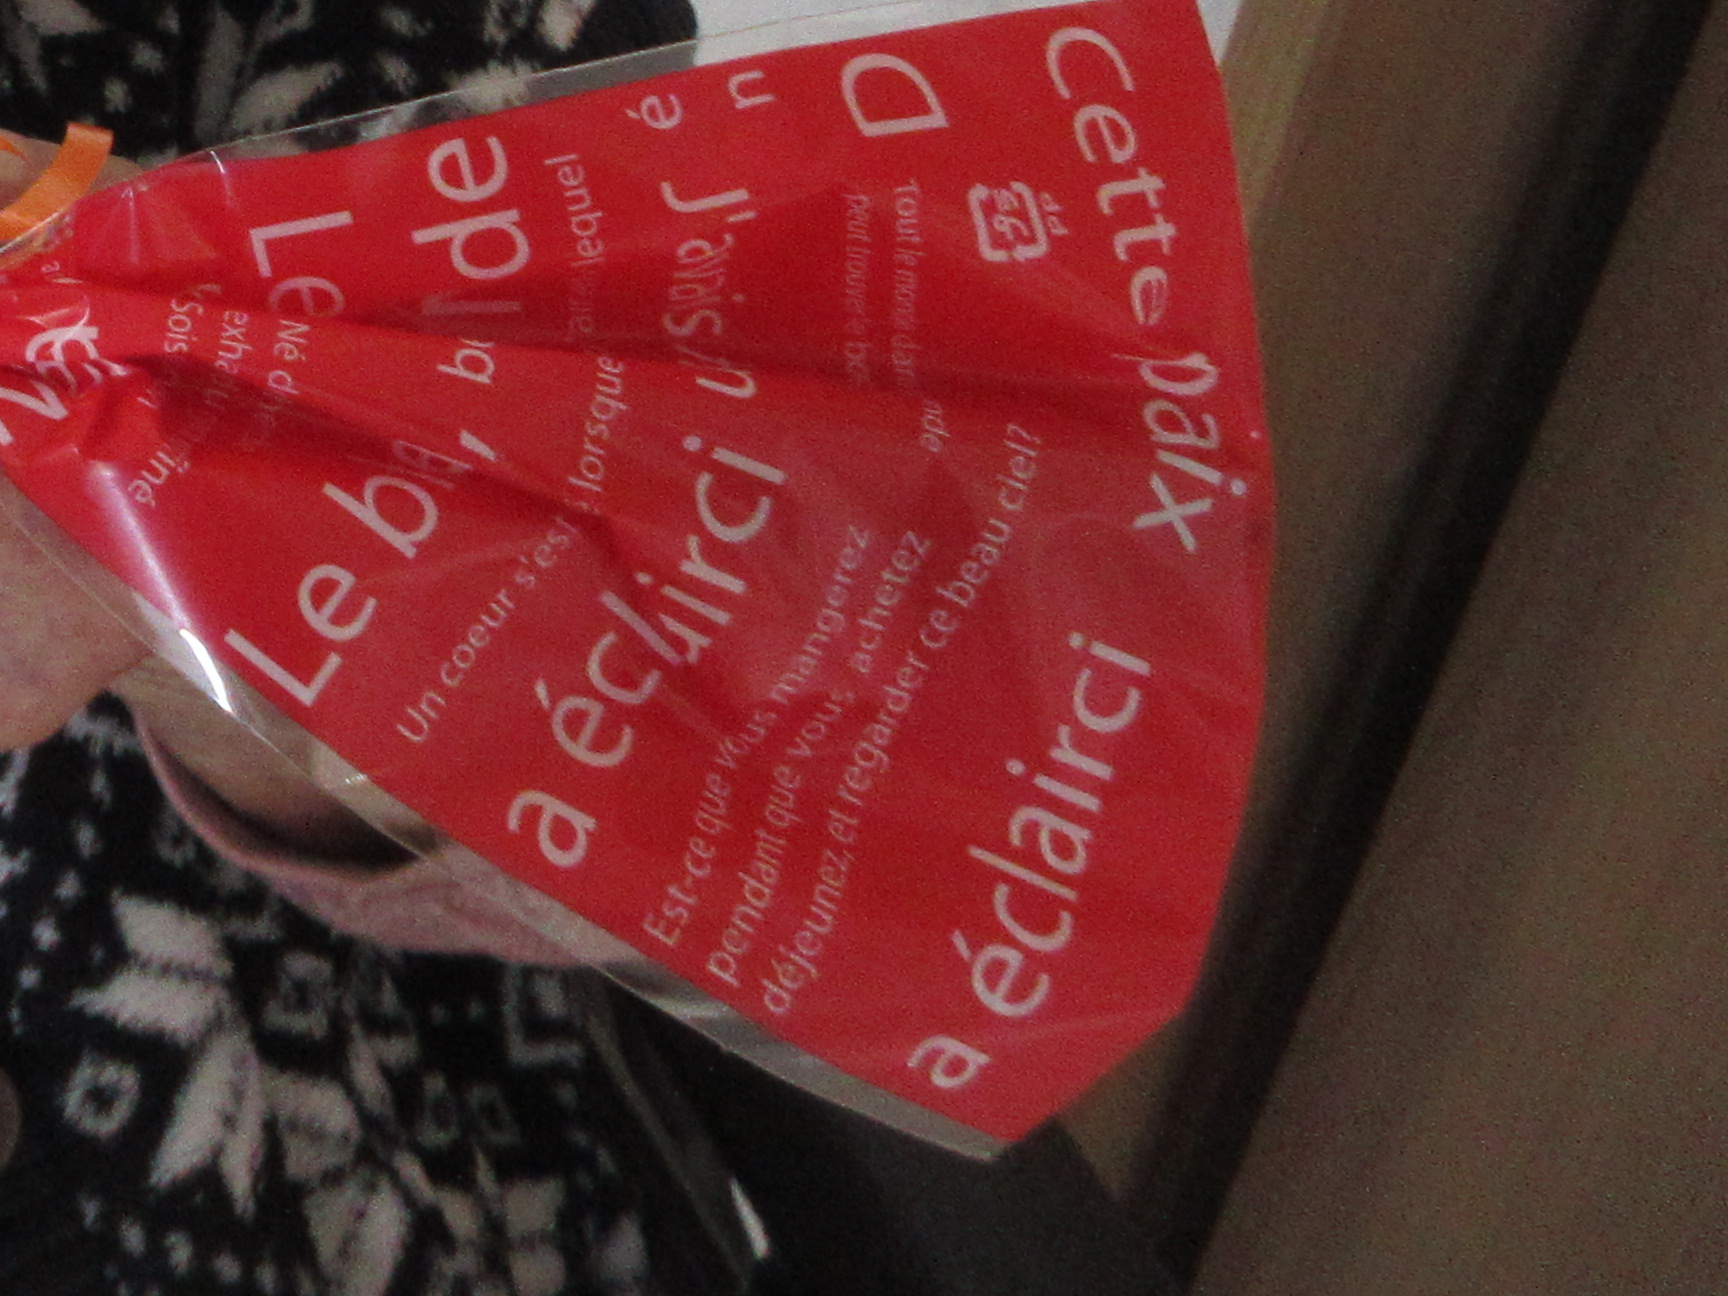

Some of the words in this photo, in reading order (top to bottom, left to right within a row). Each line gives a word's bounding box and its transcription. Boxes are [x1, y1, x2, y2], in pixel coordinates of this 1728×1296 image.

[544, 153, 605, 267] lequel
[1045, 27, 1178, 326] Cette
[1110, 351, 1247, 553] paix
[915, 606, 963, 653] ce
[934, 517, 1014, 613] beau
[396, 690, 444, 745] Un
[441, 588, 515, 689] coeur
[643, 832, 713, 947] Est-ce
[695, 769, 733, 840] que
[770, 525, 871, 708] mangerez
[842, 655, 926, 808] regarder
[705, 844, 784, 986] pendant
[765, 764, 804, 840] que
[851, 530, 934, 675] achetez
[826, 808, 859, 848] et
[906, 1035, 993, 1090] a
[950, 631, 1152, 1019] éclairci
